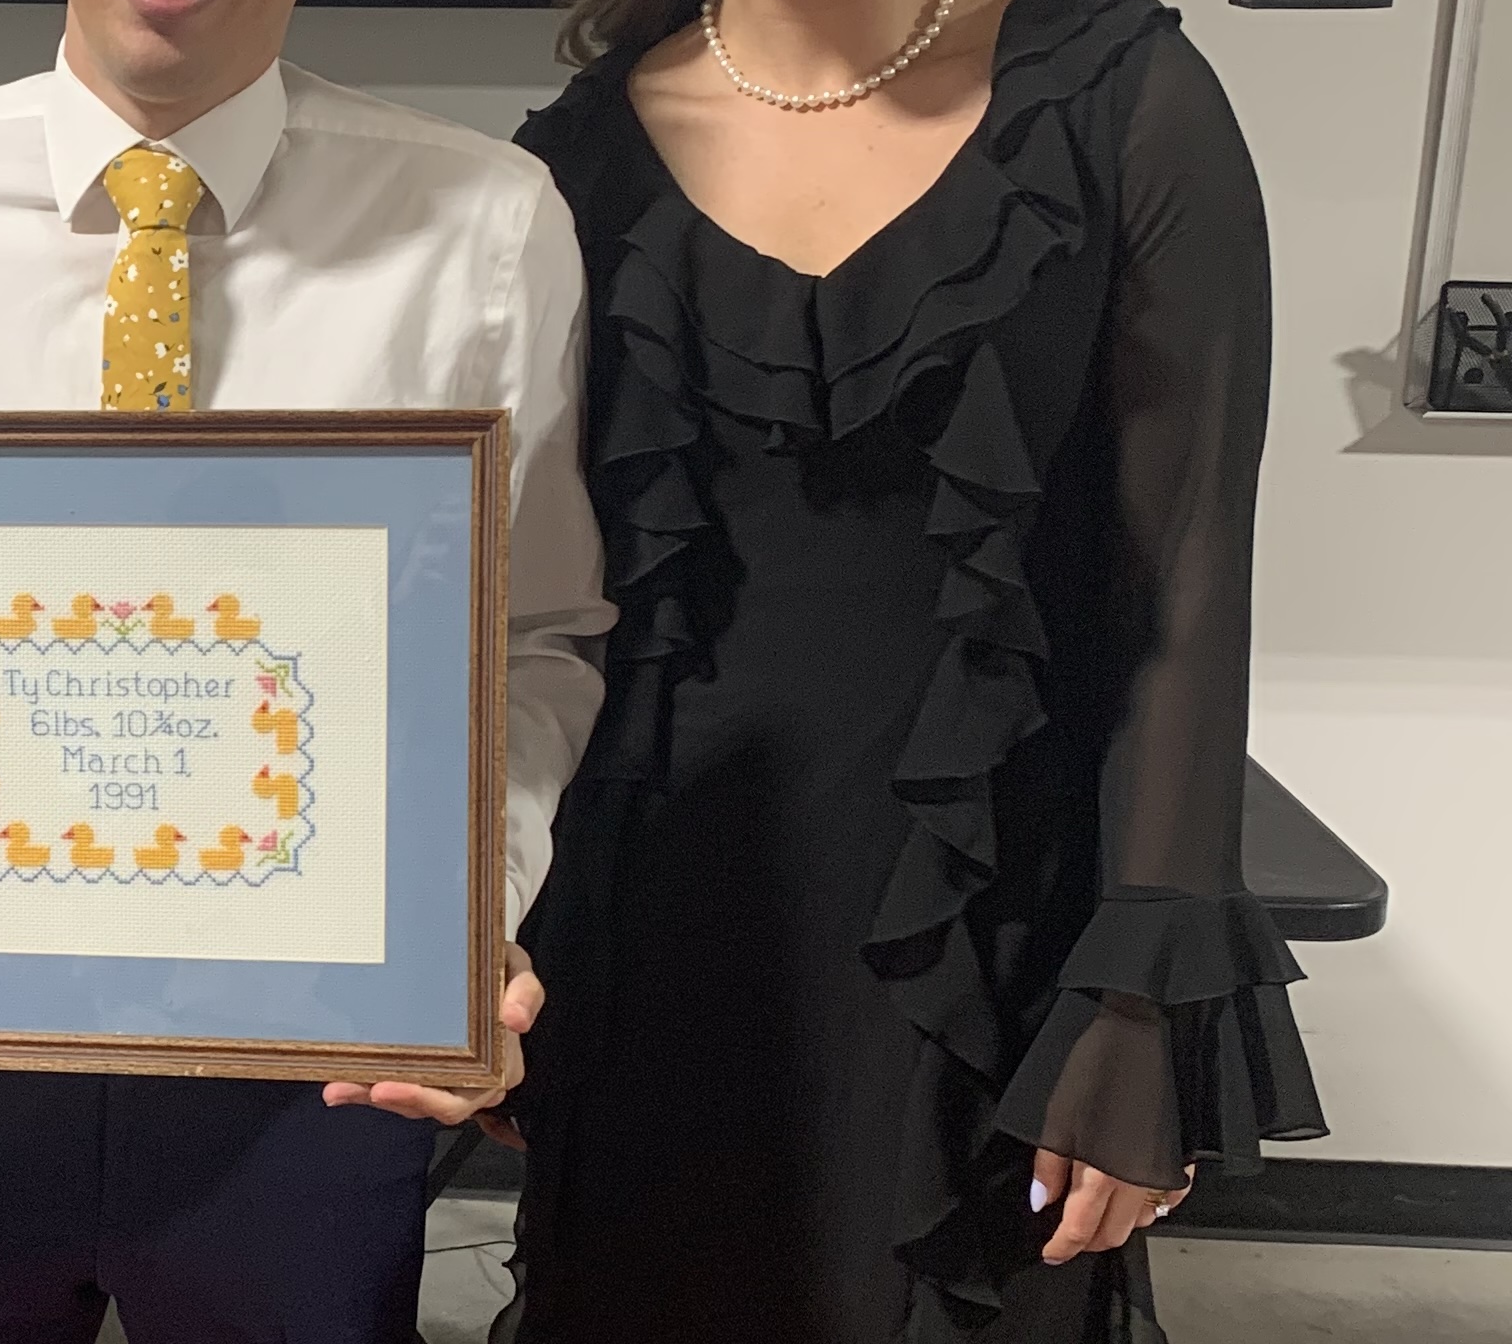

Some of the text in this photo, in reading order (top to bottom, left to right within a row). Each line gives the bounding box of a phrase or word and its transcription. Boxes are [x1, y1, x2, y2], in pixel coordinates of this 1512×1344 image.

[3, 670, 38, 704] Ty
[61, 745, 163, 774] March
[89, 782, 159, 810] 1991
